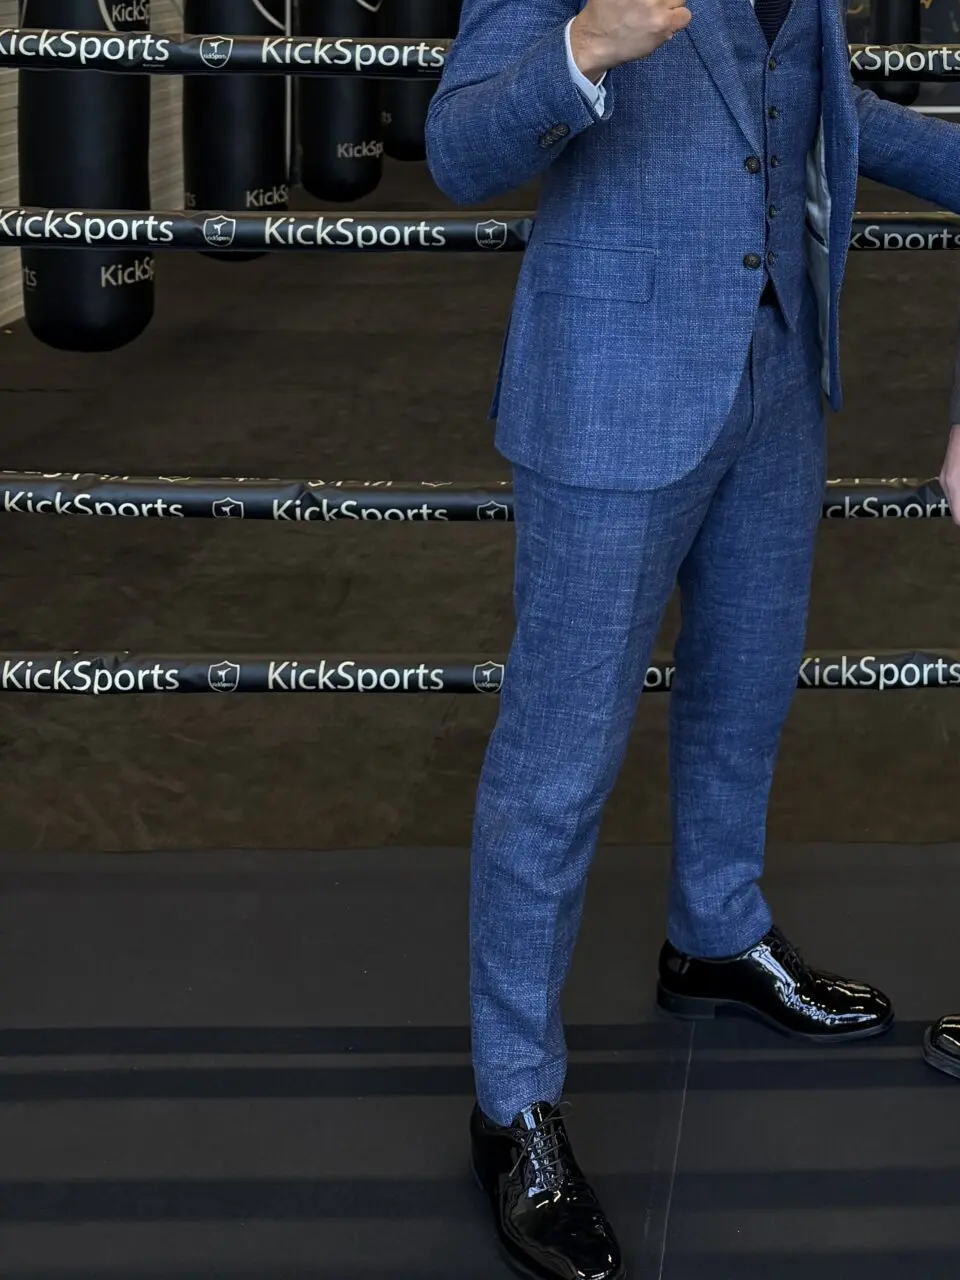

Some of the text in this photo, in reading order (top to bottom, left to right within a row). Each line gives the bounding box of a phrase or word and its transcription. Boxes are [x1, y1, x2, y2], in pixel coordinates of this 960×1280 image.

[262, 37, 445, 71] KickSports
[246, 184, 288, 208] KickS
[0, 210, 446, 248] KickSports KickSports
[3, 660, 444, 694] KickSports KickSports
